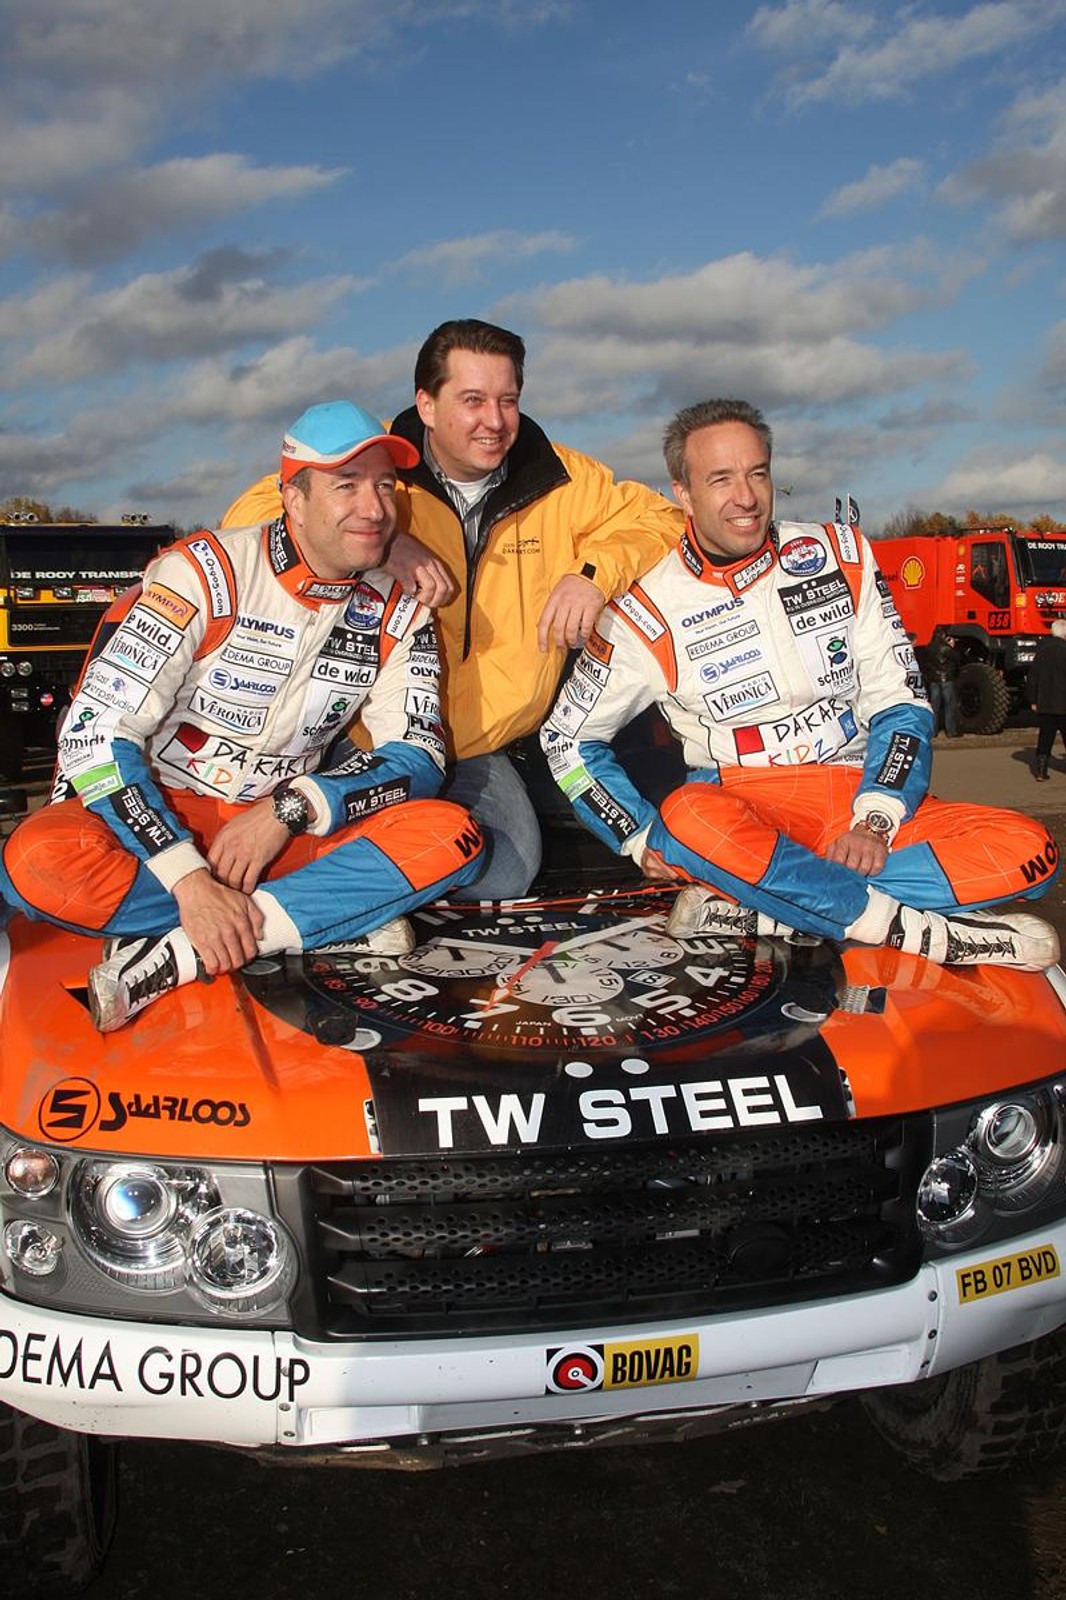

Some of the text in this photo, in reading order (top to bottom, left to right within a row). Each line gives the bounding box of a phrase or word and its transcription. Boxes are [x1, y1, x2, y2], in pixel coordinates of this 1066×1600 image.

[11, 571, 32, 579] DE
[35, 571, 76, 579] ROOY
[783, 579, 847, 607] TW STEEL
[681, 597, 745, 628] OLYMPUS
[796, 616, 817, 630] de
[990, 613, 1010, 628] 858
[690, 623, 757, 656] REDEMA GROUP
[257, 657, 291, 671] GROUP
[318, 661, 340, 679] de
[711, 681, 772, 716] VERONICA
[199, 697, 262, 728] VERONICA
[773, 698, 843, 742] DAKAR
[213, 741, 298, 778] DAKAR
[768, 738, 833, 767] KIDZ
[186, 757, 257, 798] KIDZ
[884, 752, 905, 783] STEEL
[348, 800, 366, 814] TW
[369, 788, 407, 808] STEEL
[588, 785, 618, 820] STEEL
[145, 823, 167, 847] TW
[617, 816, 636, 836] TW
[461, 921, 587, 937] TW STEEL
[684, 965, 731, 987] 4
[381, 978, 439, 1002] 8
[630, 988, 692, 1015] 5
[423, 1020, 456, 1035] 100
[552, 1005, 611, 1027] 6
[511, 1034, 542, 1046] 110
[578, 1035, 617, 1047] 120
[640, 1025, 681, 1040] 130
[418, 1074, 823, 1148] TW STEEL
[960, 1250, 1056, 1297] FB 07 BVD
[138, 1345, 311, 1402] GROUP
[611, 1343, 692, 1385] BOVAG
